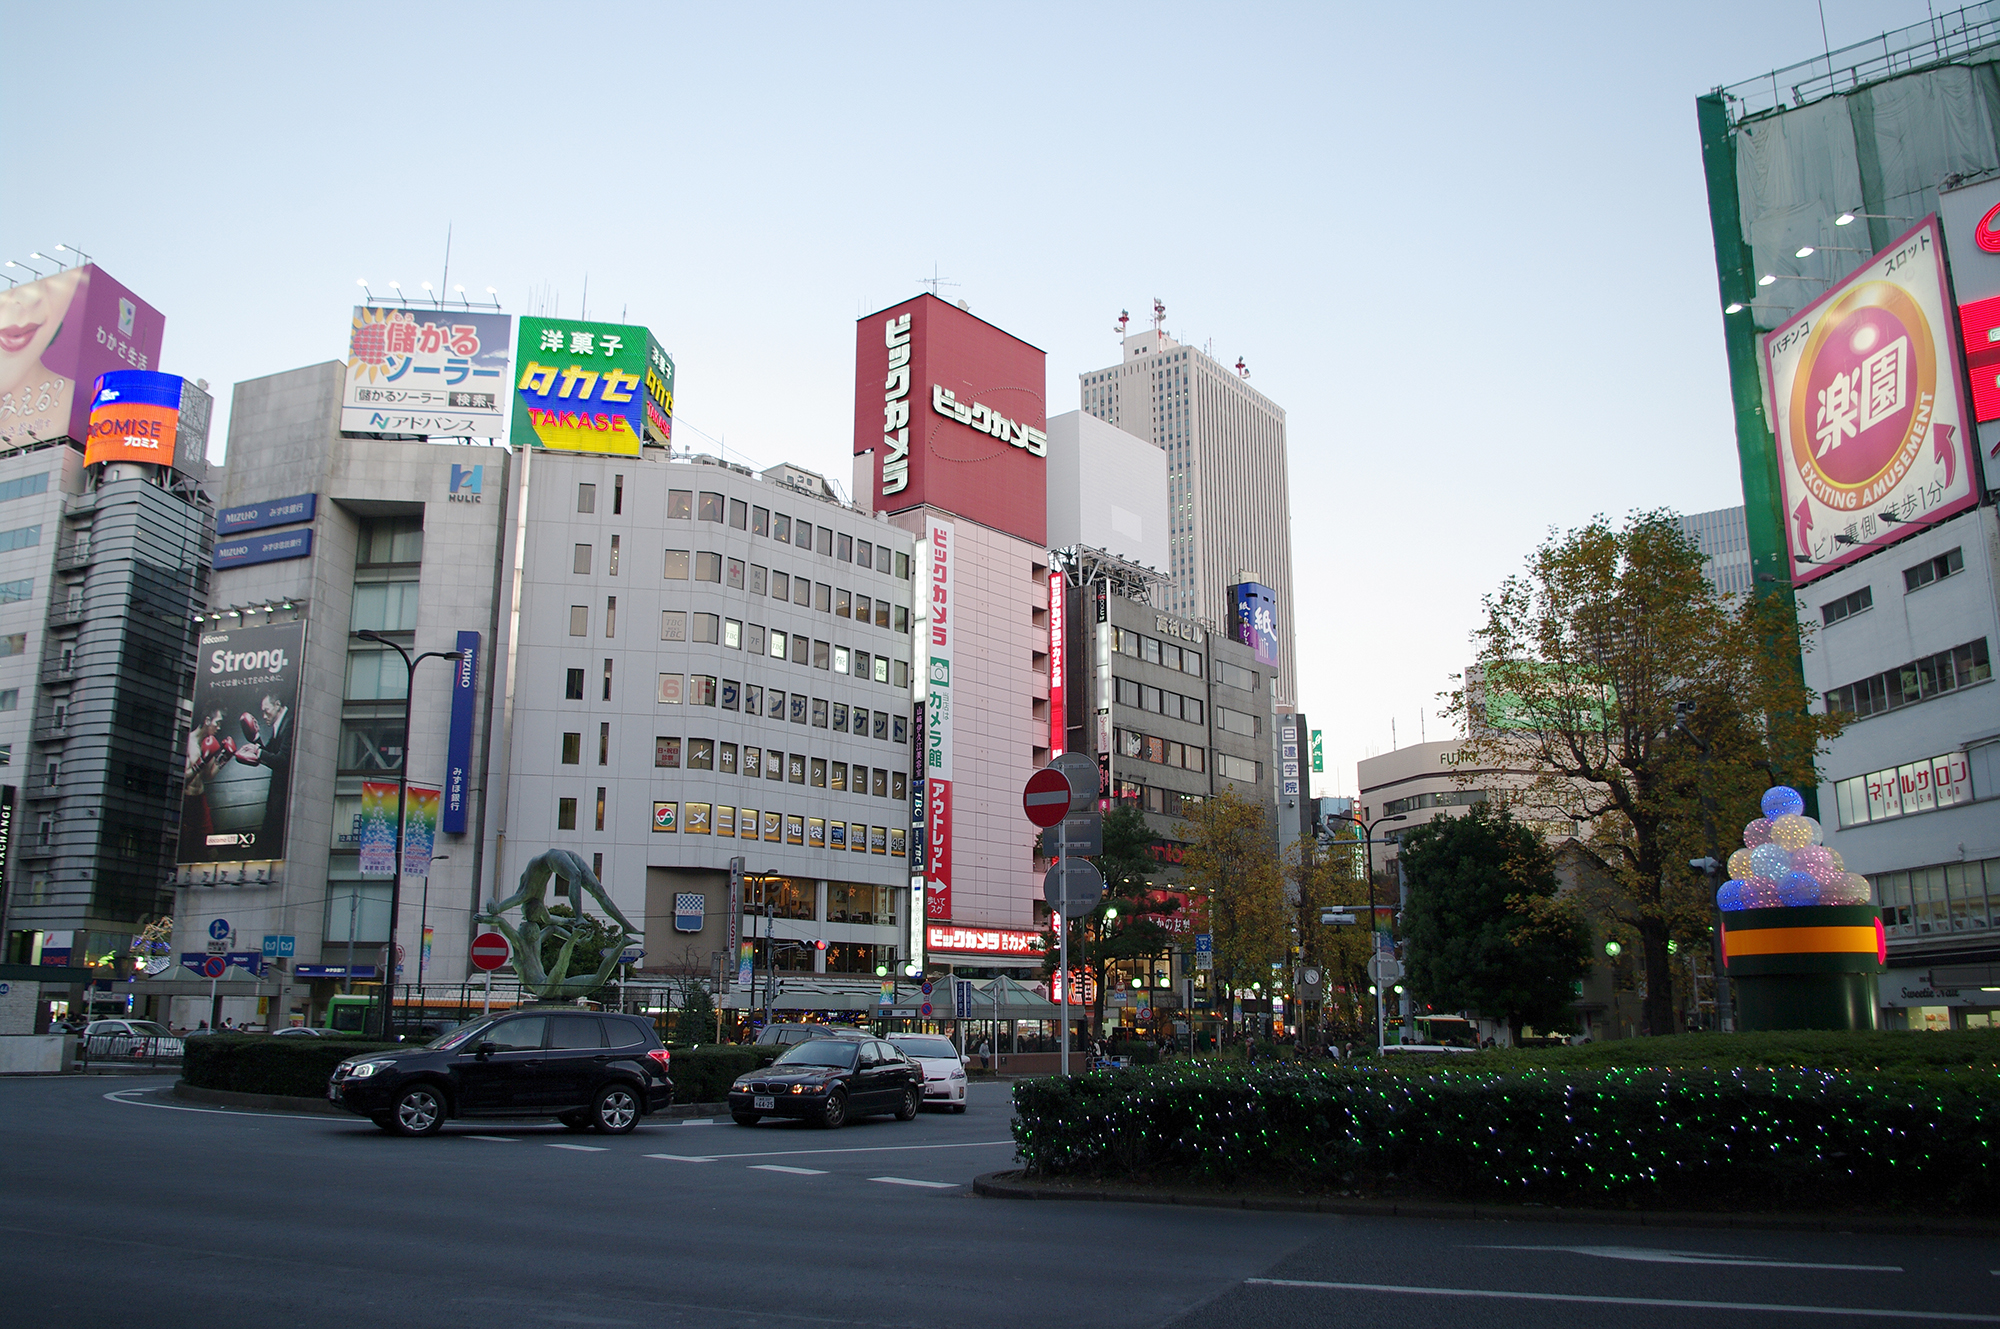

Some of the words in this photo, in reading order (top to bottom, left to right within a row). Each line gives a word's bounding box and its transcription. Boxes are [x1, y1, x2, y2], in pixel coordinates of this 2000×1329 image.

[1884, 234, 1931, 277] スロット
[97, 326, 148, 370] わかさ生活
[386, 321, 480, 355] 儲かる
[540, 329, 624, 357] 洋菓子
[1771, 320, 1811, 360] パチンコ
[386, 355, 500, 386] ソーラー
[518, 361, 641, 403] タカセ
[358, 389, 445, 404] 儲かるソーラー
[456, 393, 487, 408] 検索
[646, 366, 674, 418] タカセ
[882, 312, 911, 496] ビックカメラ
[1815, 334, 1908, 460] 楽園
[392, 415, 476, 432] アドバンス
[527, 407, 626, 433] TAKASE
[646, 401, 672, 439] TAKASE
[932, 383, 1048, 458] ビックカメラ
[124, 435, 159, 449] プロミス
[1800, 460, 1857, 510] EXCITING
[1861, 392, 1933, 506] AMUSEMENT
[269, 503, 304, 517] みずほ銀行
[448, 494, 481, 504] HULIC
[225, 510, 258, 524] MIZUHO
[219, 546, 248, 557] MIZUHO
[262, 538, 302, 552] みずほ信託銀行
[932, 527, 947, 646] ビックカメラ
[1051, 575, 1061, 640] ビックカメラ
[665, 630, 682, 638] TBC
[666, 619, 683, 627] TBC
[1254, 607, 1277, 642] 紙
[750, 637, 760, 645] 7F
[210, 648, 288, 674] Strong.
[460, 648, 473, 689] MIZUHO
[857, 663, 866, 671] B1
[929, 691, 942, 768] カメラ館
[722, 749, 902, 792] 中安眼科クリニック
[1282, 726, 1298, 796] 日建学院
[450, 767, 462, 811] みずほ銀行
[1868, 761, 1967, 801] ネイルサロン
[914, 790, 923, 817] TBC
[689, 812, 823, 841] メニコン池袋
[931, 782, 945, 874] アウトレット
[891, 838, 905, 850] 4F
[927, 897, 946, 906] 歩いて
[930, 906, 943, 914] スグ
[1149, 916, 1191, 933] かの友梨
[930, 929, 999, 950] ビックカメラ
[42, 956, 67, 964] PROMISE
[1901, 986, 1934, 999] Sweetie
